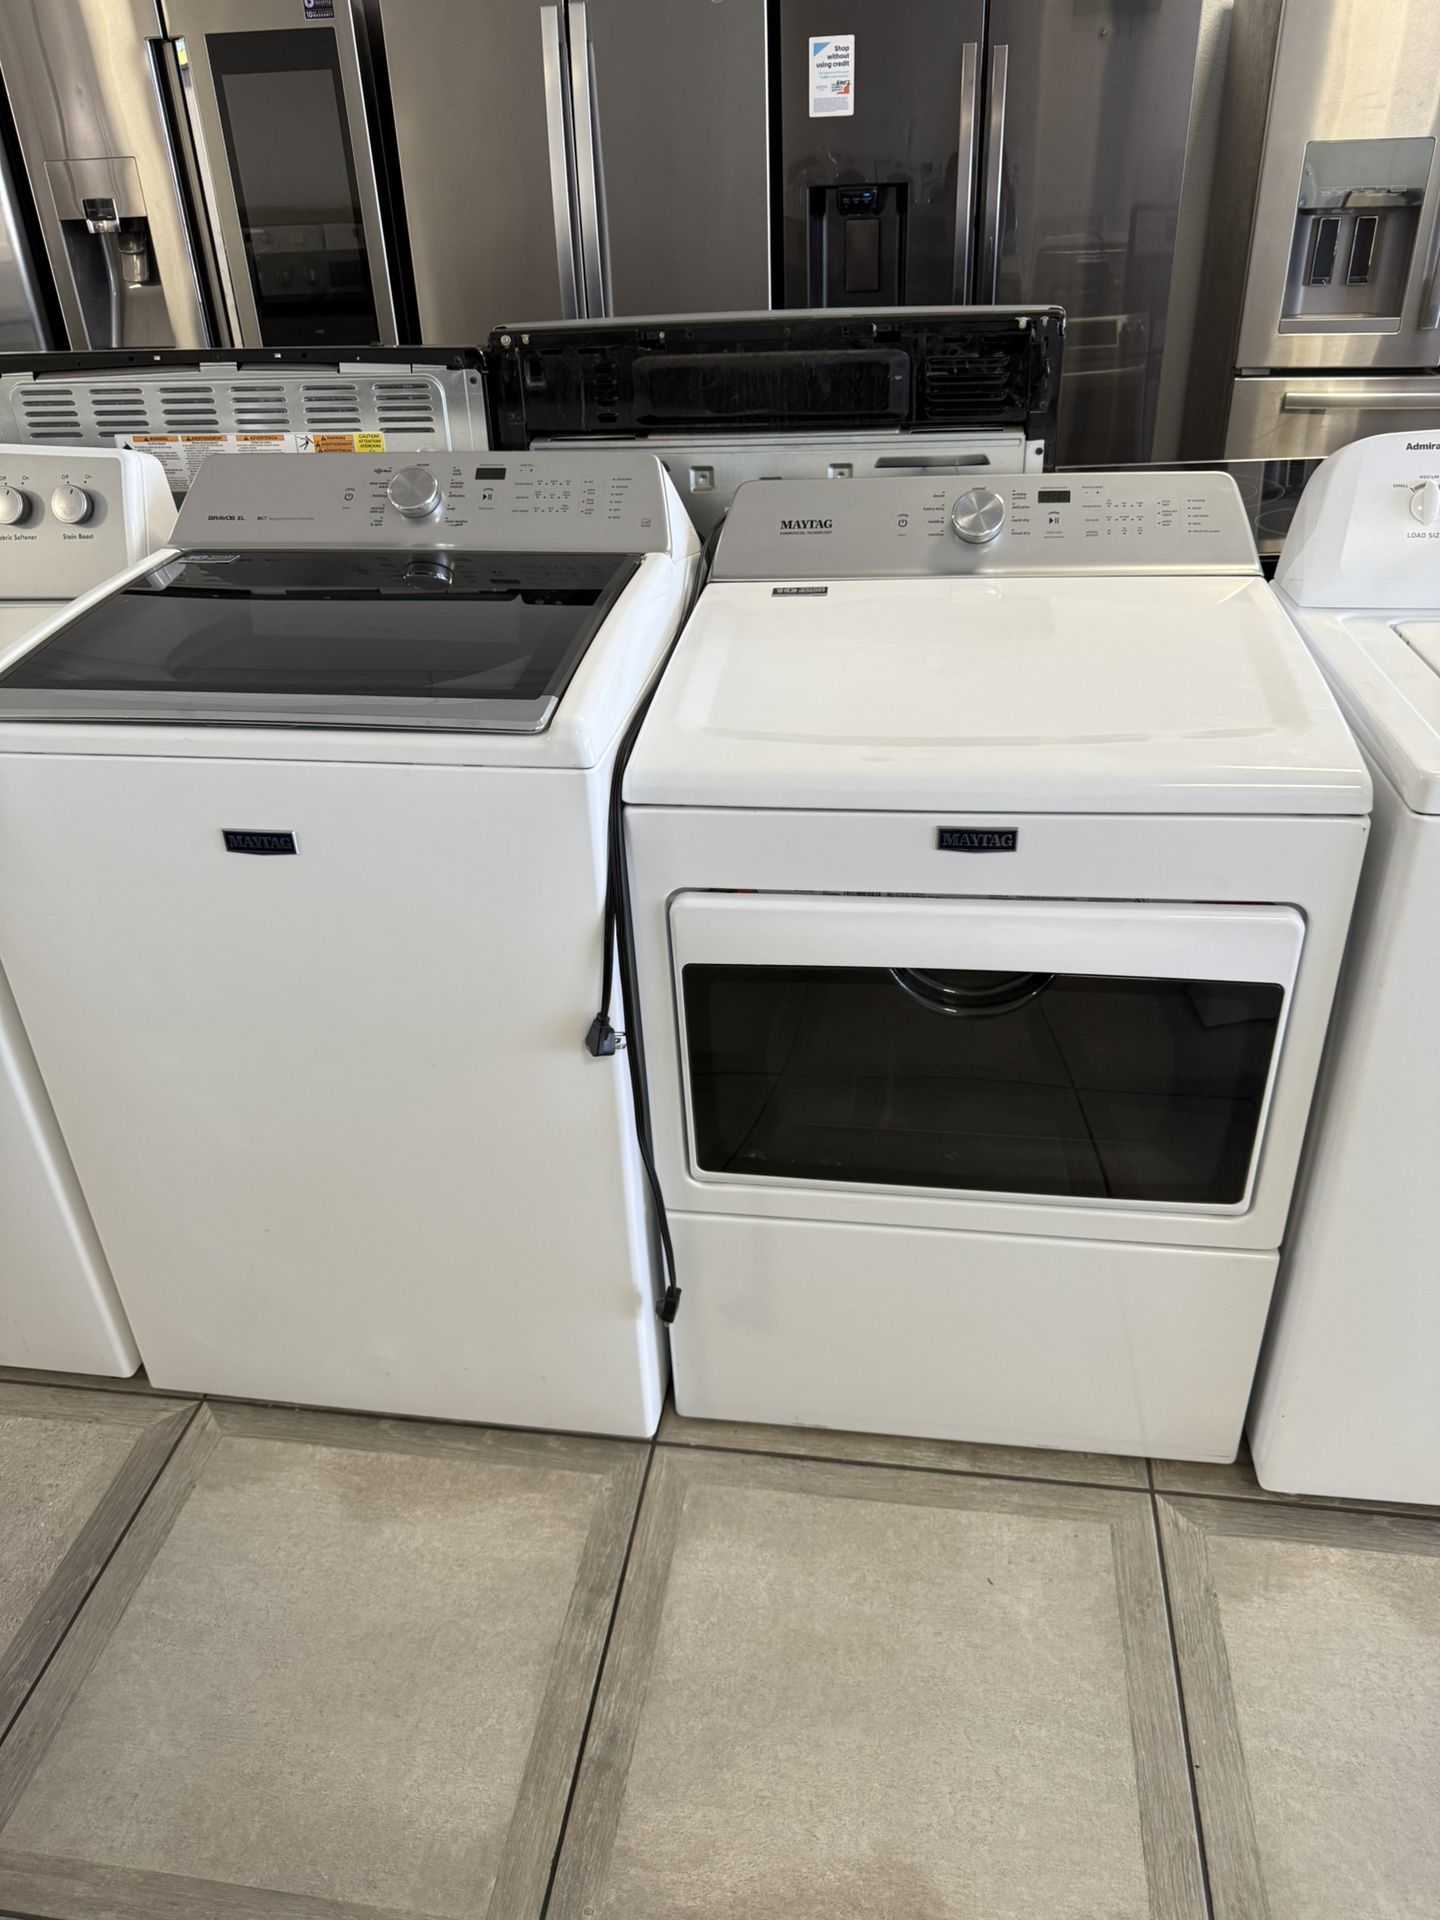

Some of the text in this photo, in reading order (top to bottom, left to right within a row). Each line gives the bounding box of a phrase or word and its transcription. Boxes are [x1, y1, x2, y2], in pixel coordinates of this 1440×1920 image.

[1405, 442, 1440, 451] Admira
[780, 519, 833, 530] MAYTAG
[227, 834, 293, 849] MAYTAG
[942, 833, 1014, 847] MAYTAG
